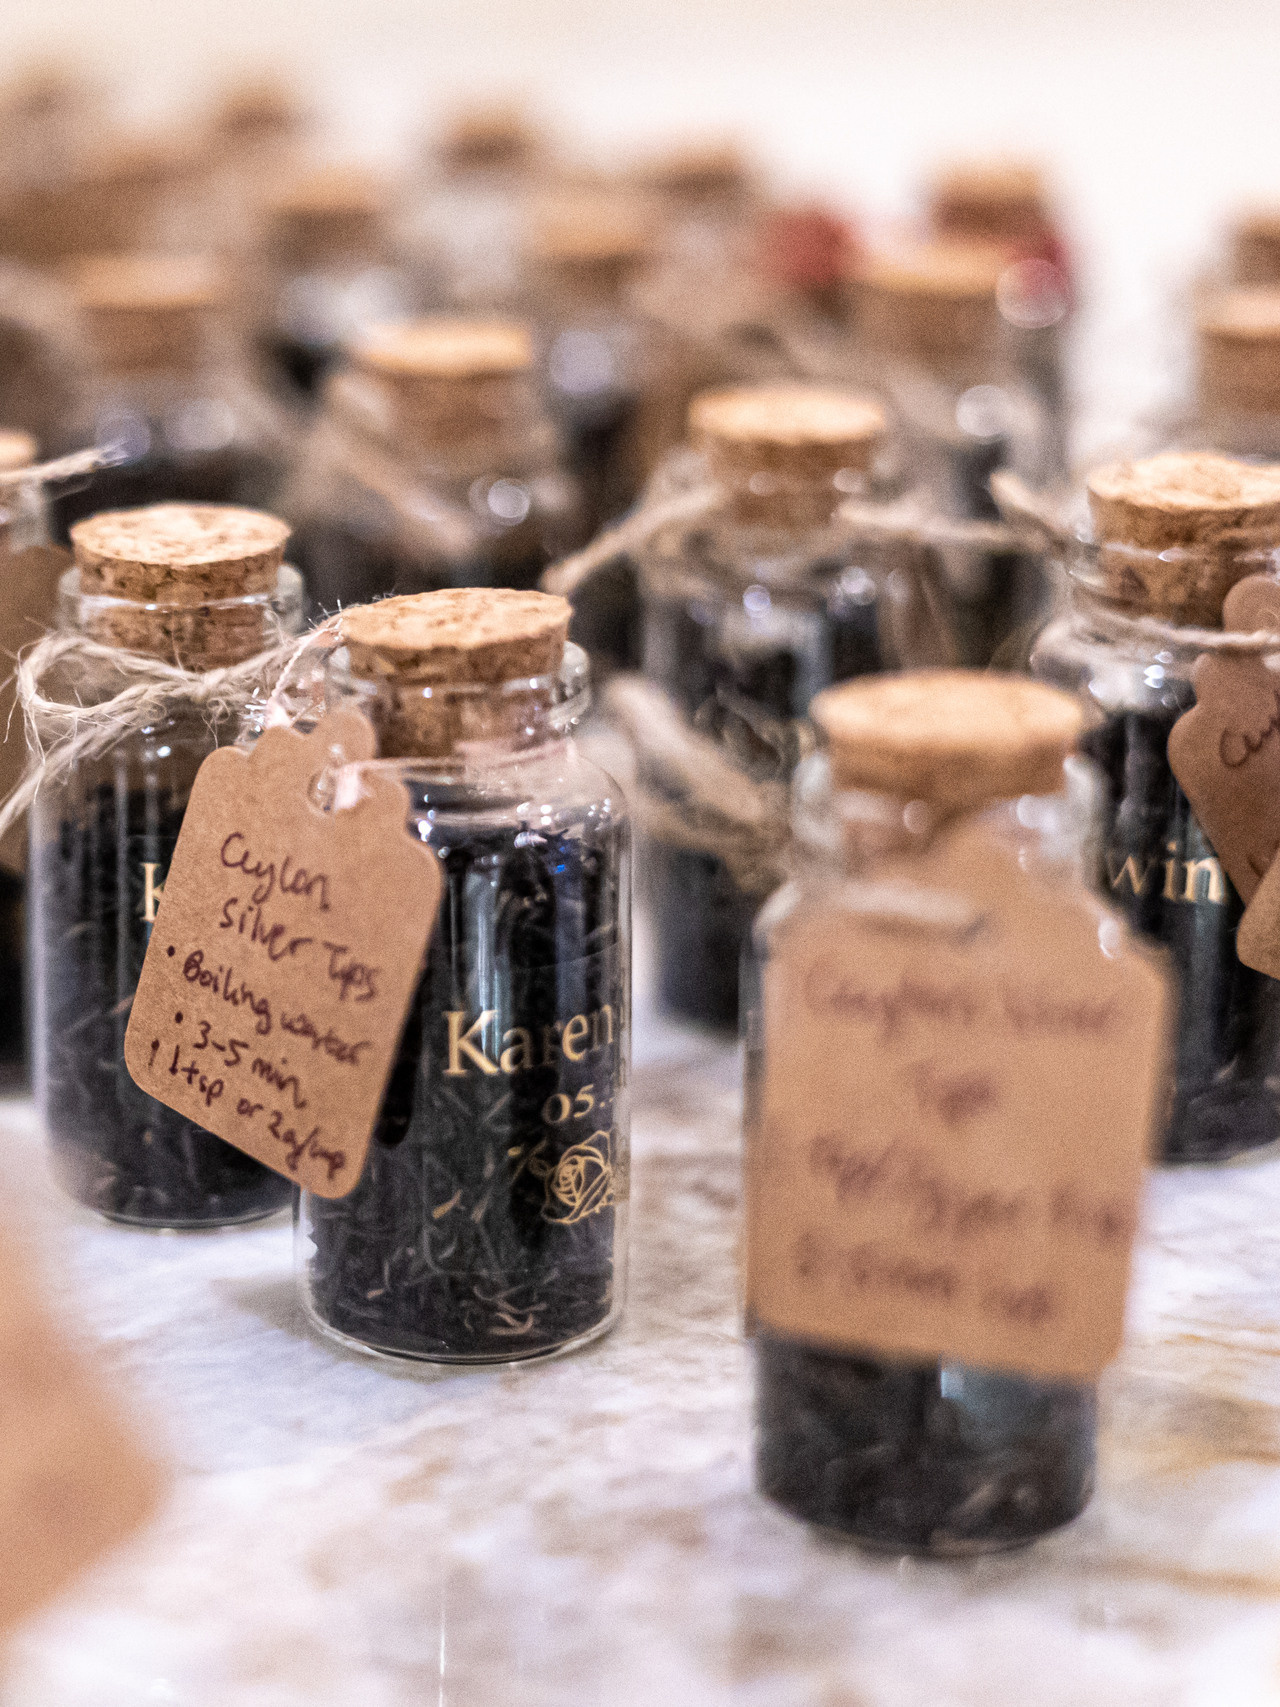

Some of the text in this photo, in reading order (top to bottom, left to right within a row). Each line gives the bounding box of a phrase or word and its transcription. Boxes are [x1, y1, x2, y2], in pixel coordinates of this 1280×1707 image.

[220, 897, 313, 961] Silver
[183, 949, 271, 1035] Boiling
[193, 1020, 308, 1110] 3-5 min
[442, 1004, 615, 1077] Karen
[237, 1098, 265, 1118] or
